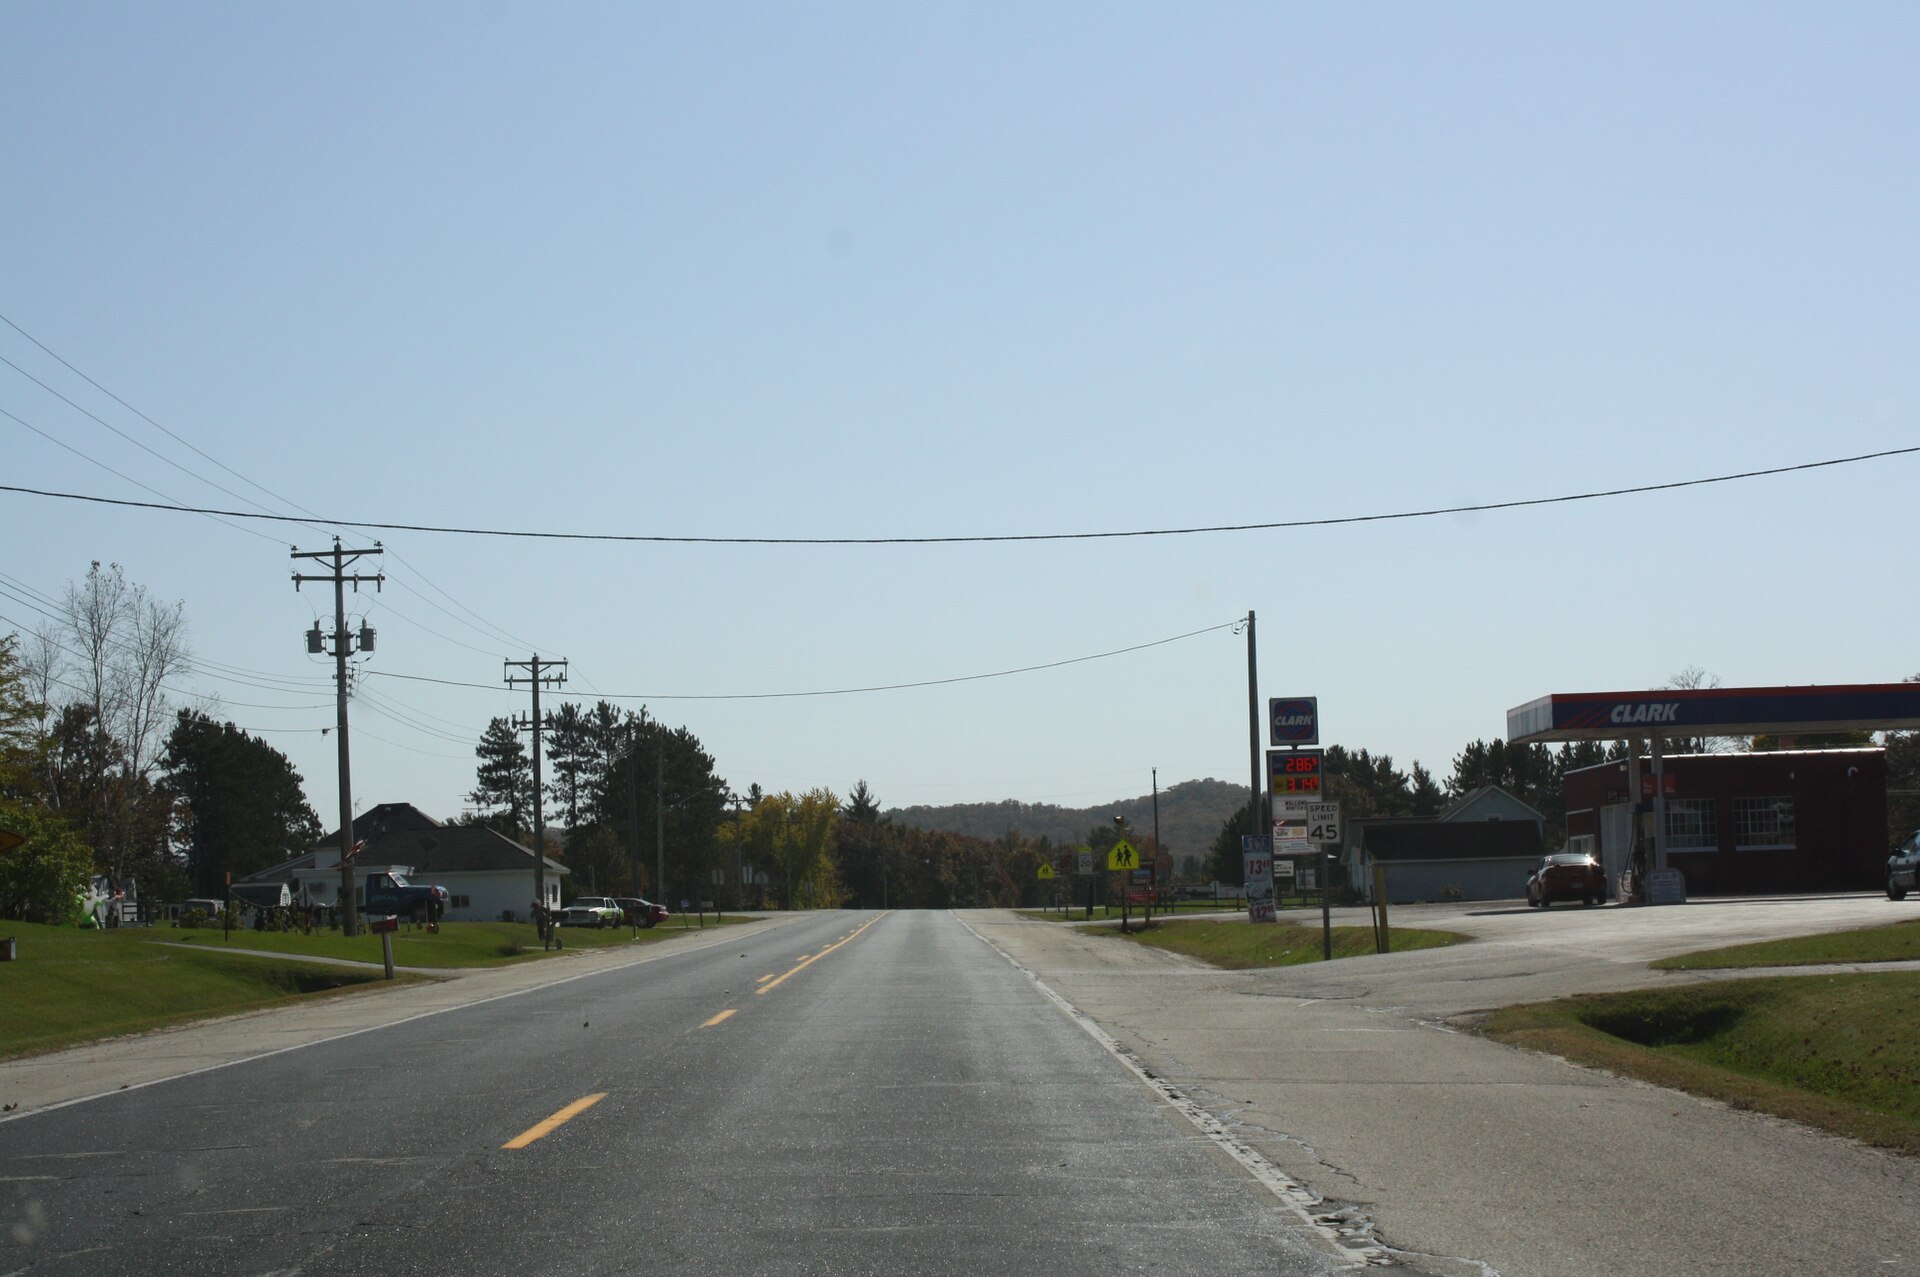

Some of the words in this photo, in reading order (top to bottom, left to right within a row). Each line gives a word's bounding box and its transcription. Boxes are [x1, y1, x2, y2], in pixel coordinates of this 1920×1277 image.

[1611, 703, 1680, 723] CLARK
[1275, 715, 1313, 726] CLARK
[1310, 804, 1338, 812] SPEED
[1312, 813, 1335, 821] LIMIT
[1311, 824, 1338, 840] 45
